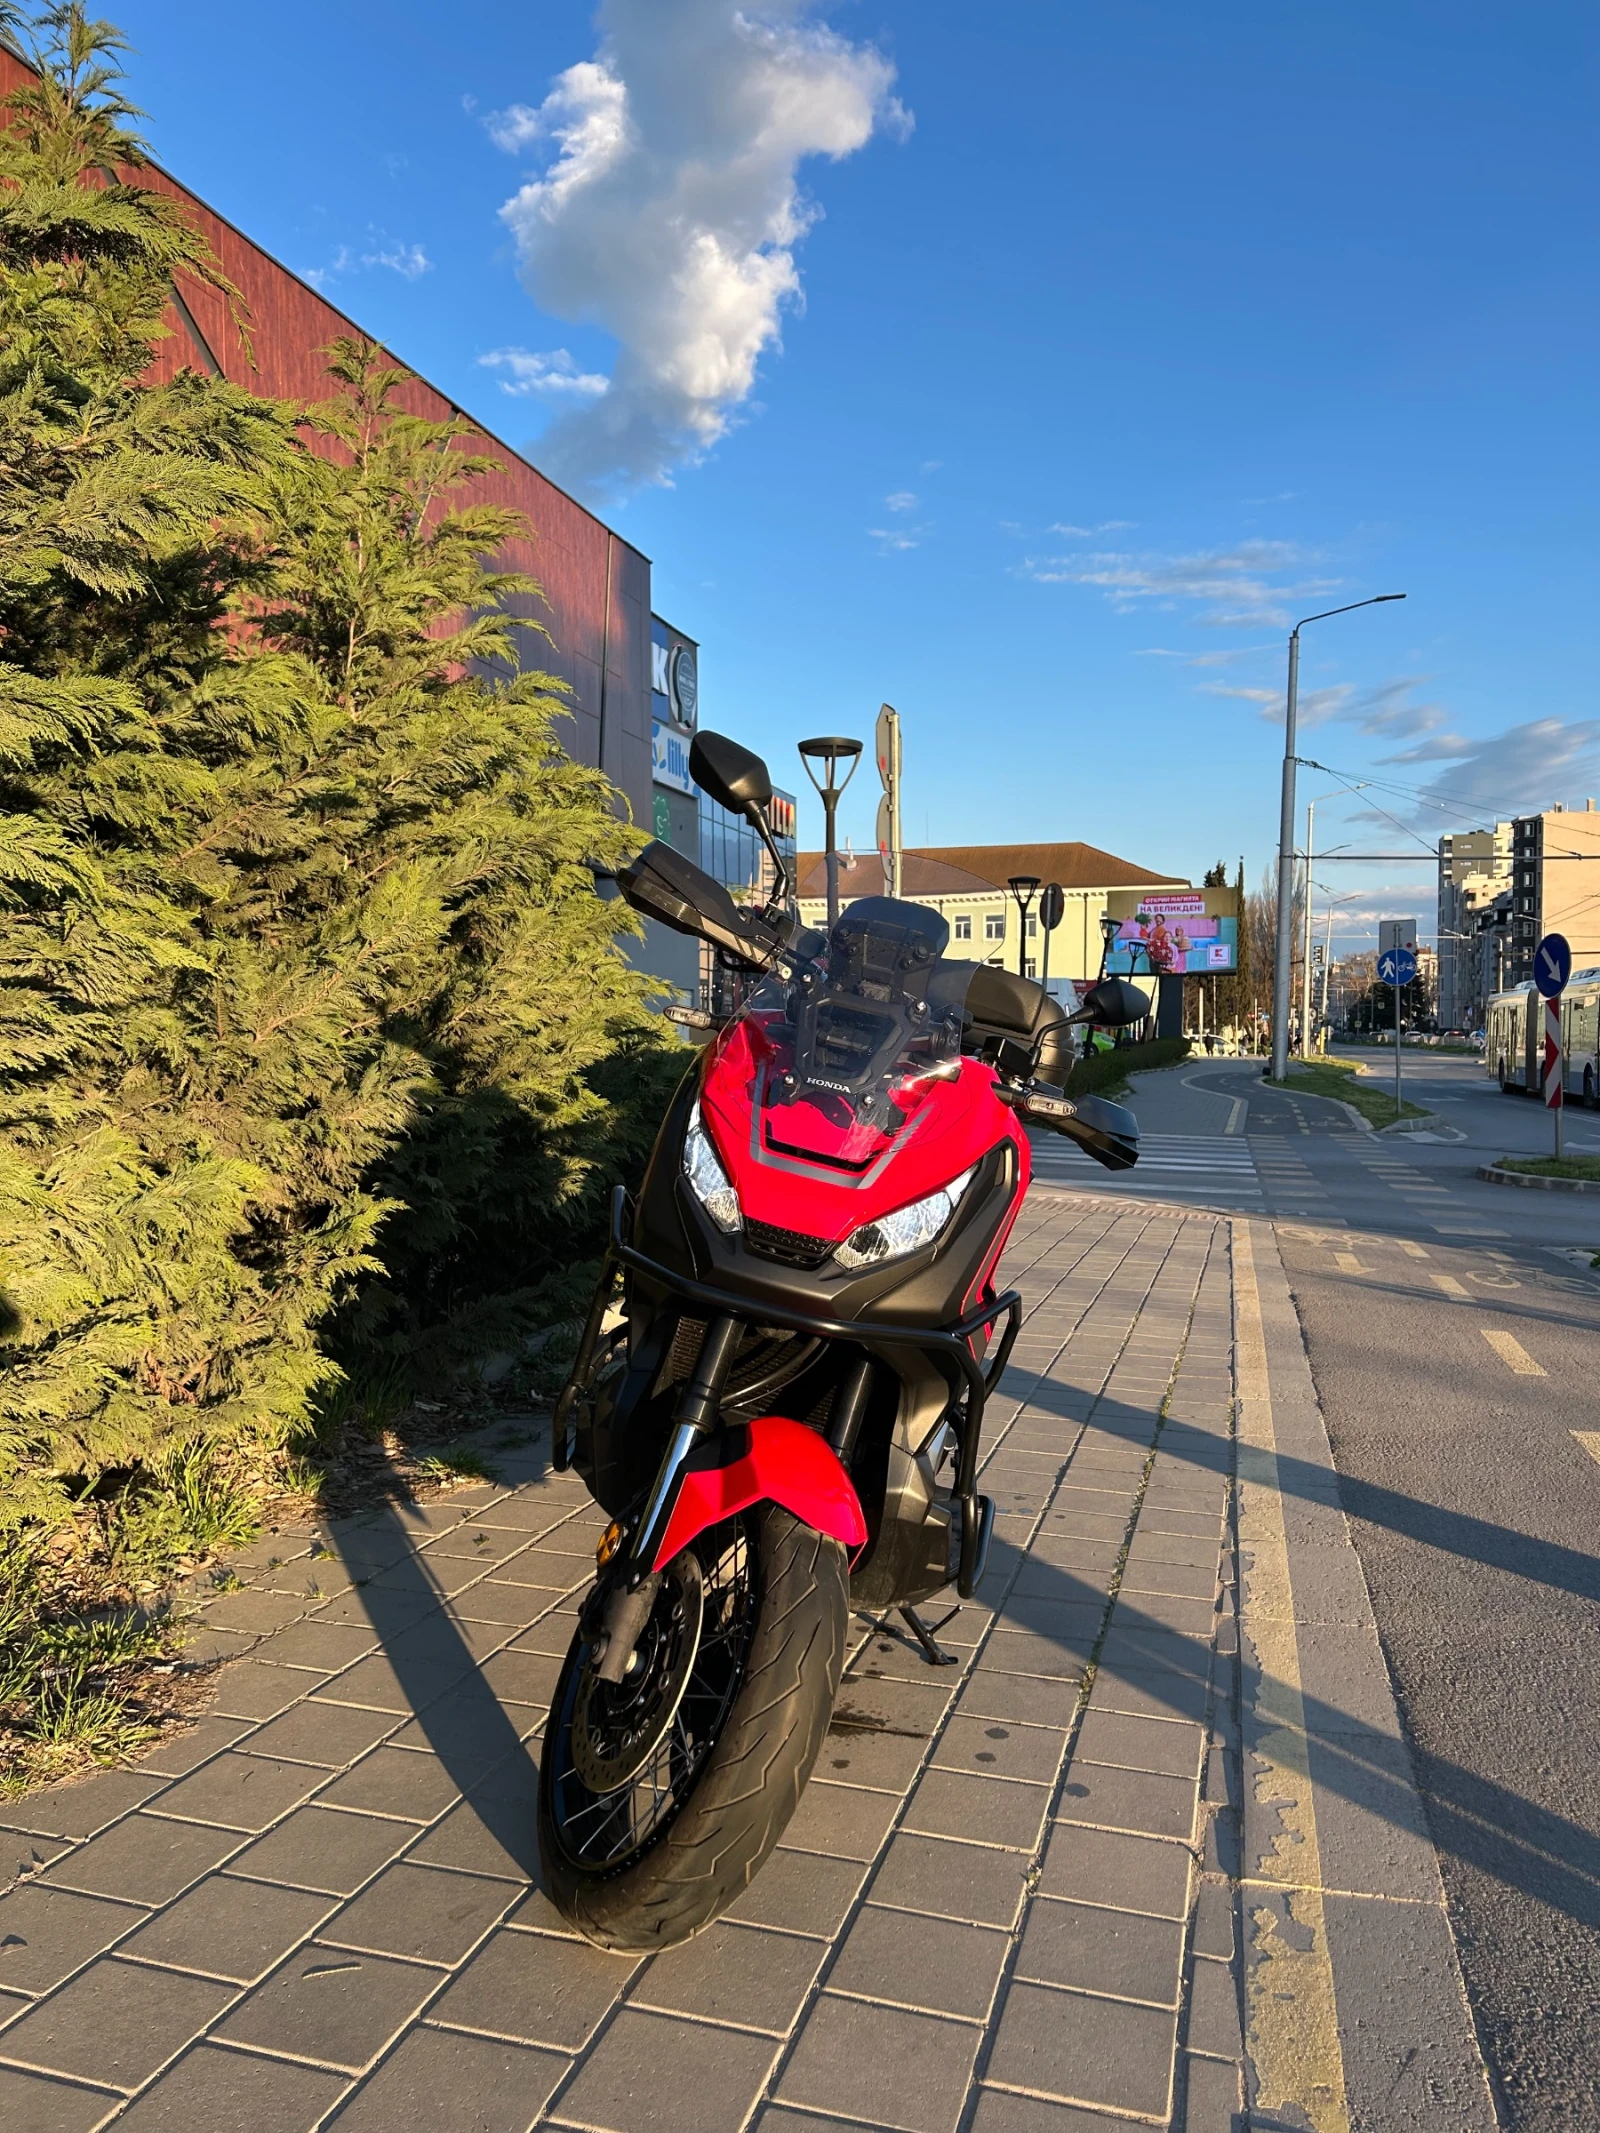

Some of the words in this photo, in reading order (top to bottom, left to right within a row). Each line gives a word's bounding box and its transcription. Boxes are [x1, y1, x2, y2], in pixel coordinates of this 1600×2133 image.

[667, 737, 689, 790] lilly
[1153, 904, 1203, 912] ВЕЛИКДЕН!
[806, 1077, 851, 1093] HONDA
